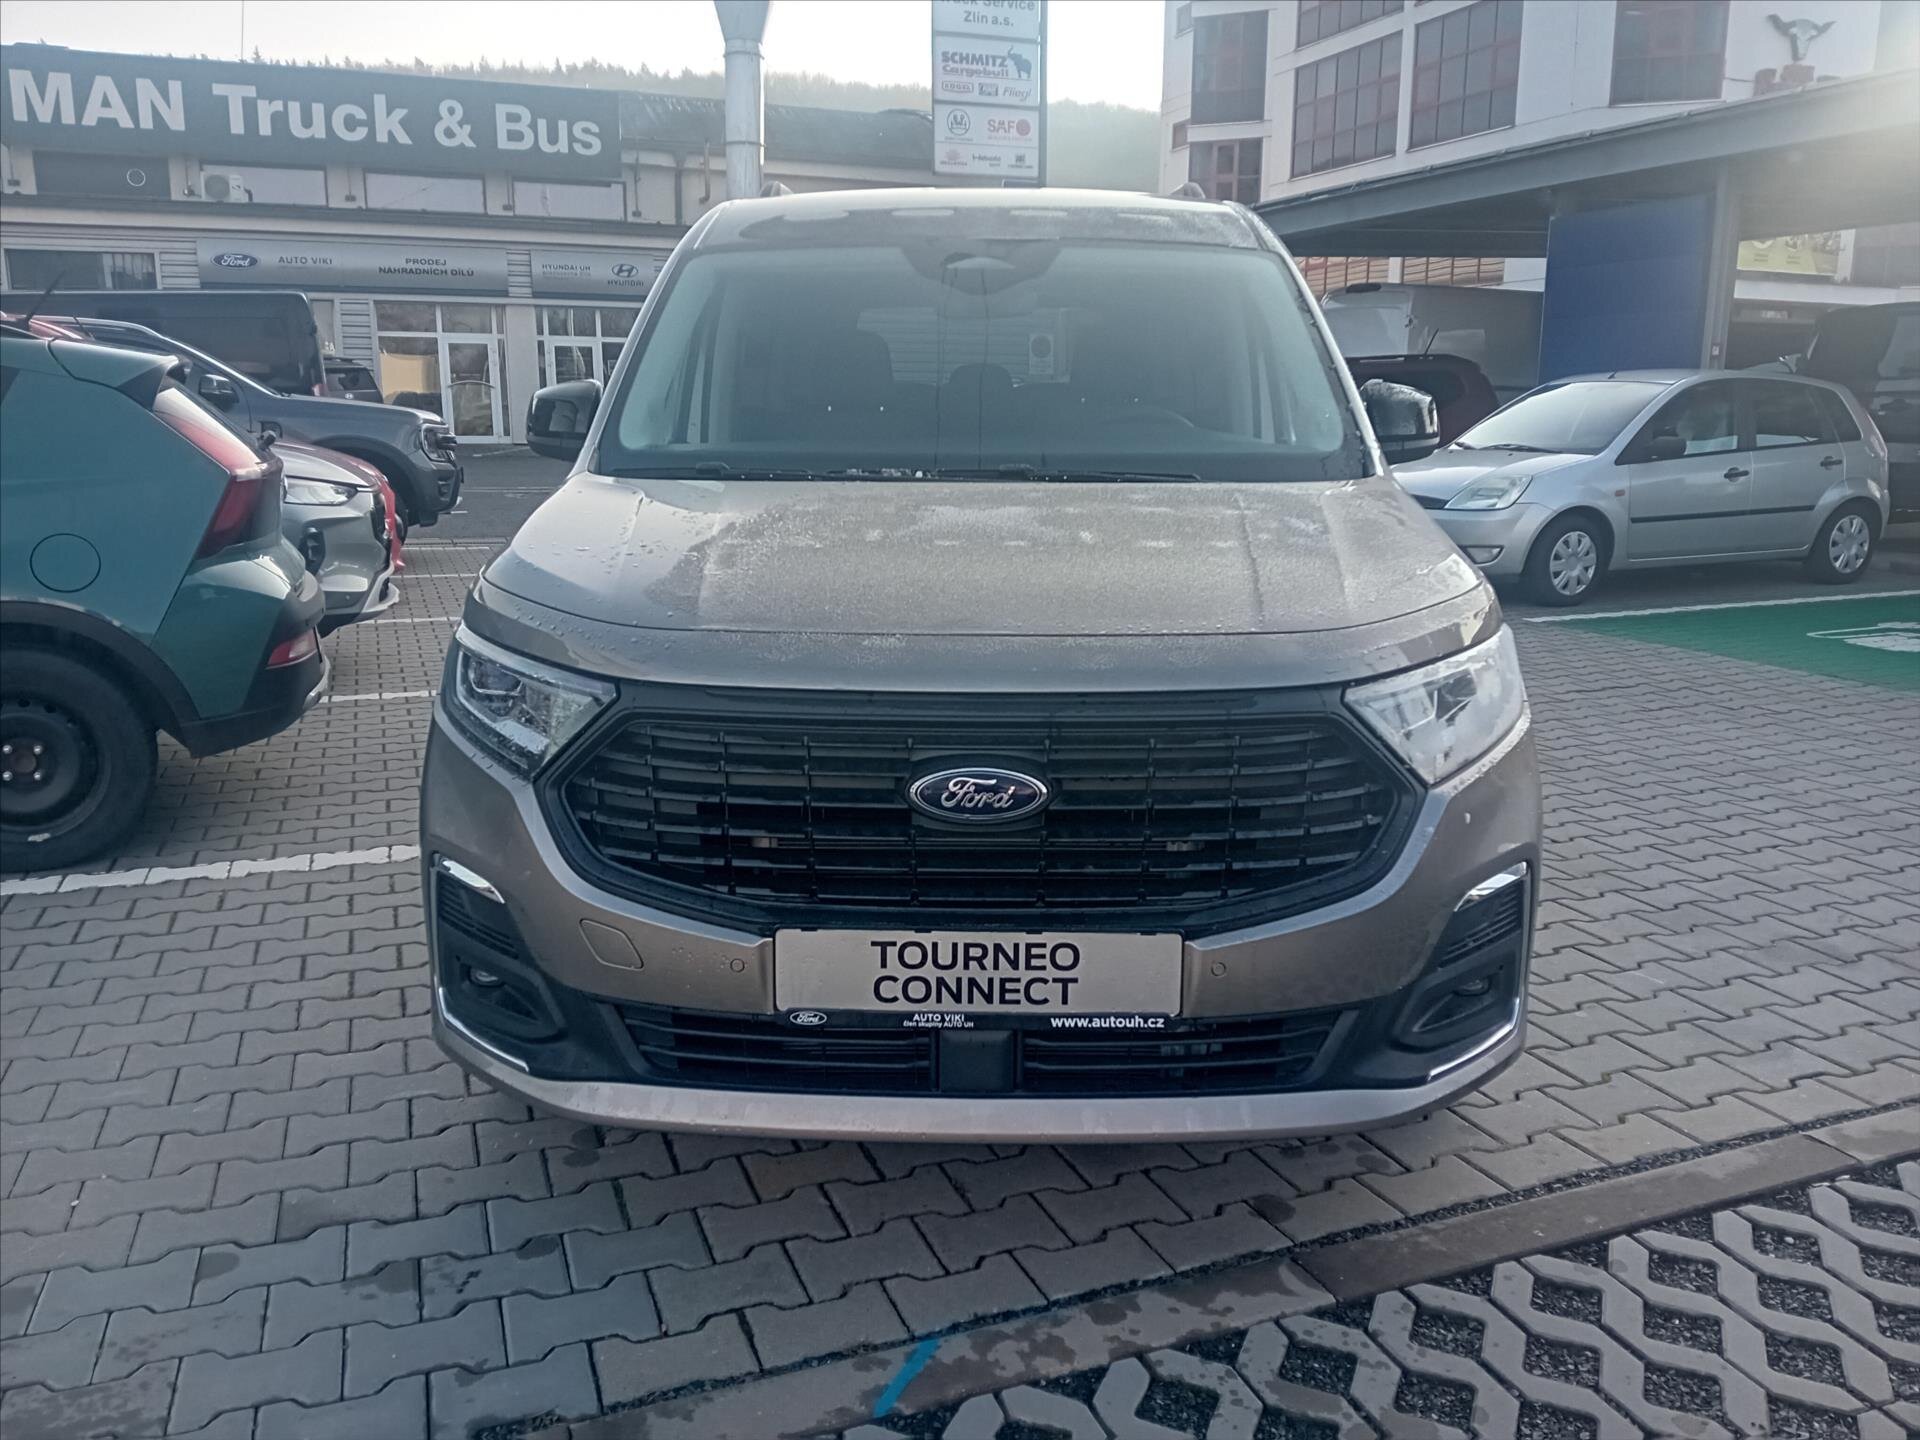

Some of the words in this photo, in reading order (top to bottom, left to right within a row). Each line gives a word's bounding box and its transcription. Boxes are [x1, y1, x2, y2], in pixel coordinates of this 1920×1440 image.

[941, 51, 1009, 68] SCHMITZ
[8, 69, 186, 131] MAN
[211, 83, 412, 145] Truck
[434, 99, 477, 148] &
[495, 103, 602, 156] Bus
[221, 254, 251, 268] Ford
[278, 256, 308, 265] AUTO
[311, 257, 333, 265] VIKI
[405, 258, 447, 266] PRODEJ
[542, 263, 578, 271] HYUNDAI
[607, 279, 644, 288] HYUNDAI
[941, 777, 1016, 810] Ford
[870, 940, 1081, 972] TOURNEO
[873, 975, 1079, 1006] CONNECT
[913, 1013, 942, 1022] AUTO
[944, 1013, 965, 1022] VIKI
[1050, 1015, 1165, 1028] www.autouh.cz
